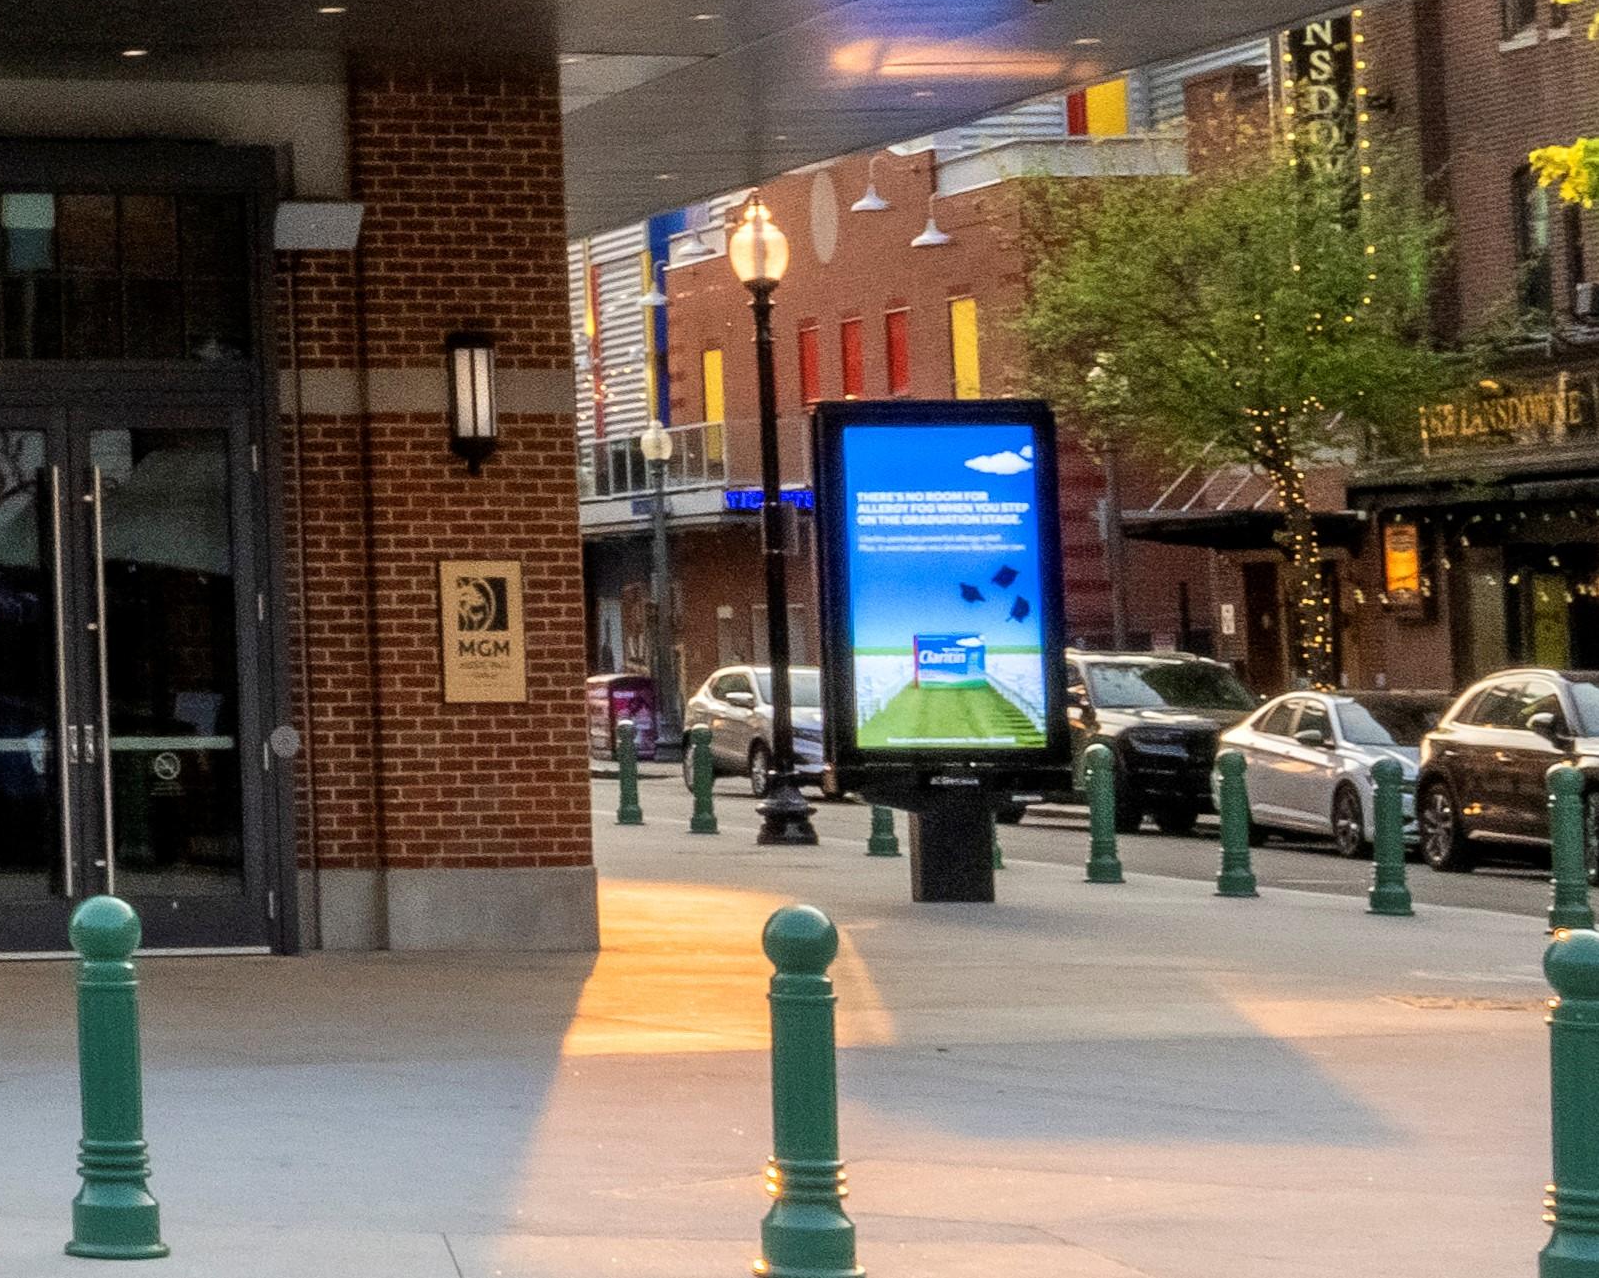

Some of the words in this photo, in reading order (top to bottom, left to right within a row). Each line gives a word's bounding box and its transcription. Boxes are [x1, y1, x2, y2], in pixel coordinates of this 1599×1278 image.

[1460, 390, 1583, 437] LANSDOWE
[905, 491, 925, 502] NO
[964, 491, 989, 502] FOR
[975, 503, 999, 514] YOU
[1000, 502, 1029, 513] STEP
[857, 514, 877, 525] ON
[458, 639, 510, 657] MGM
